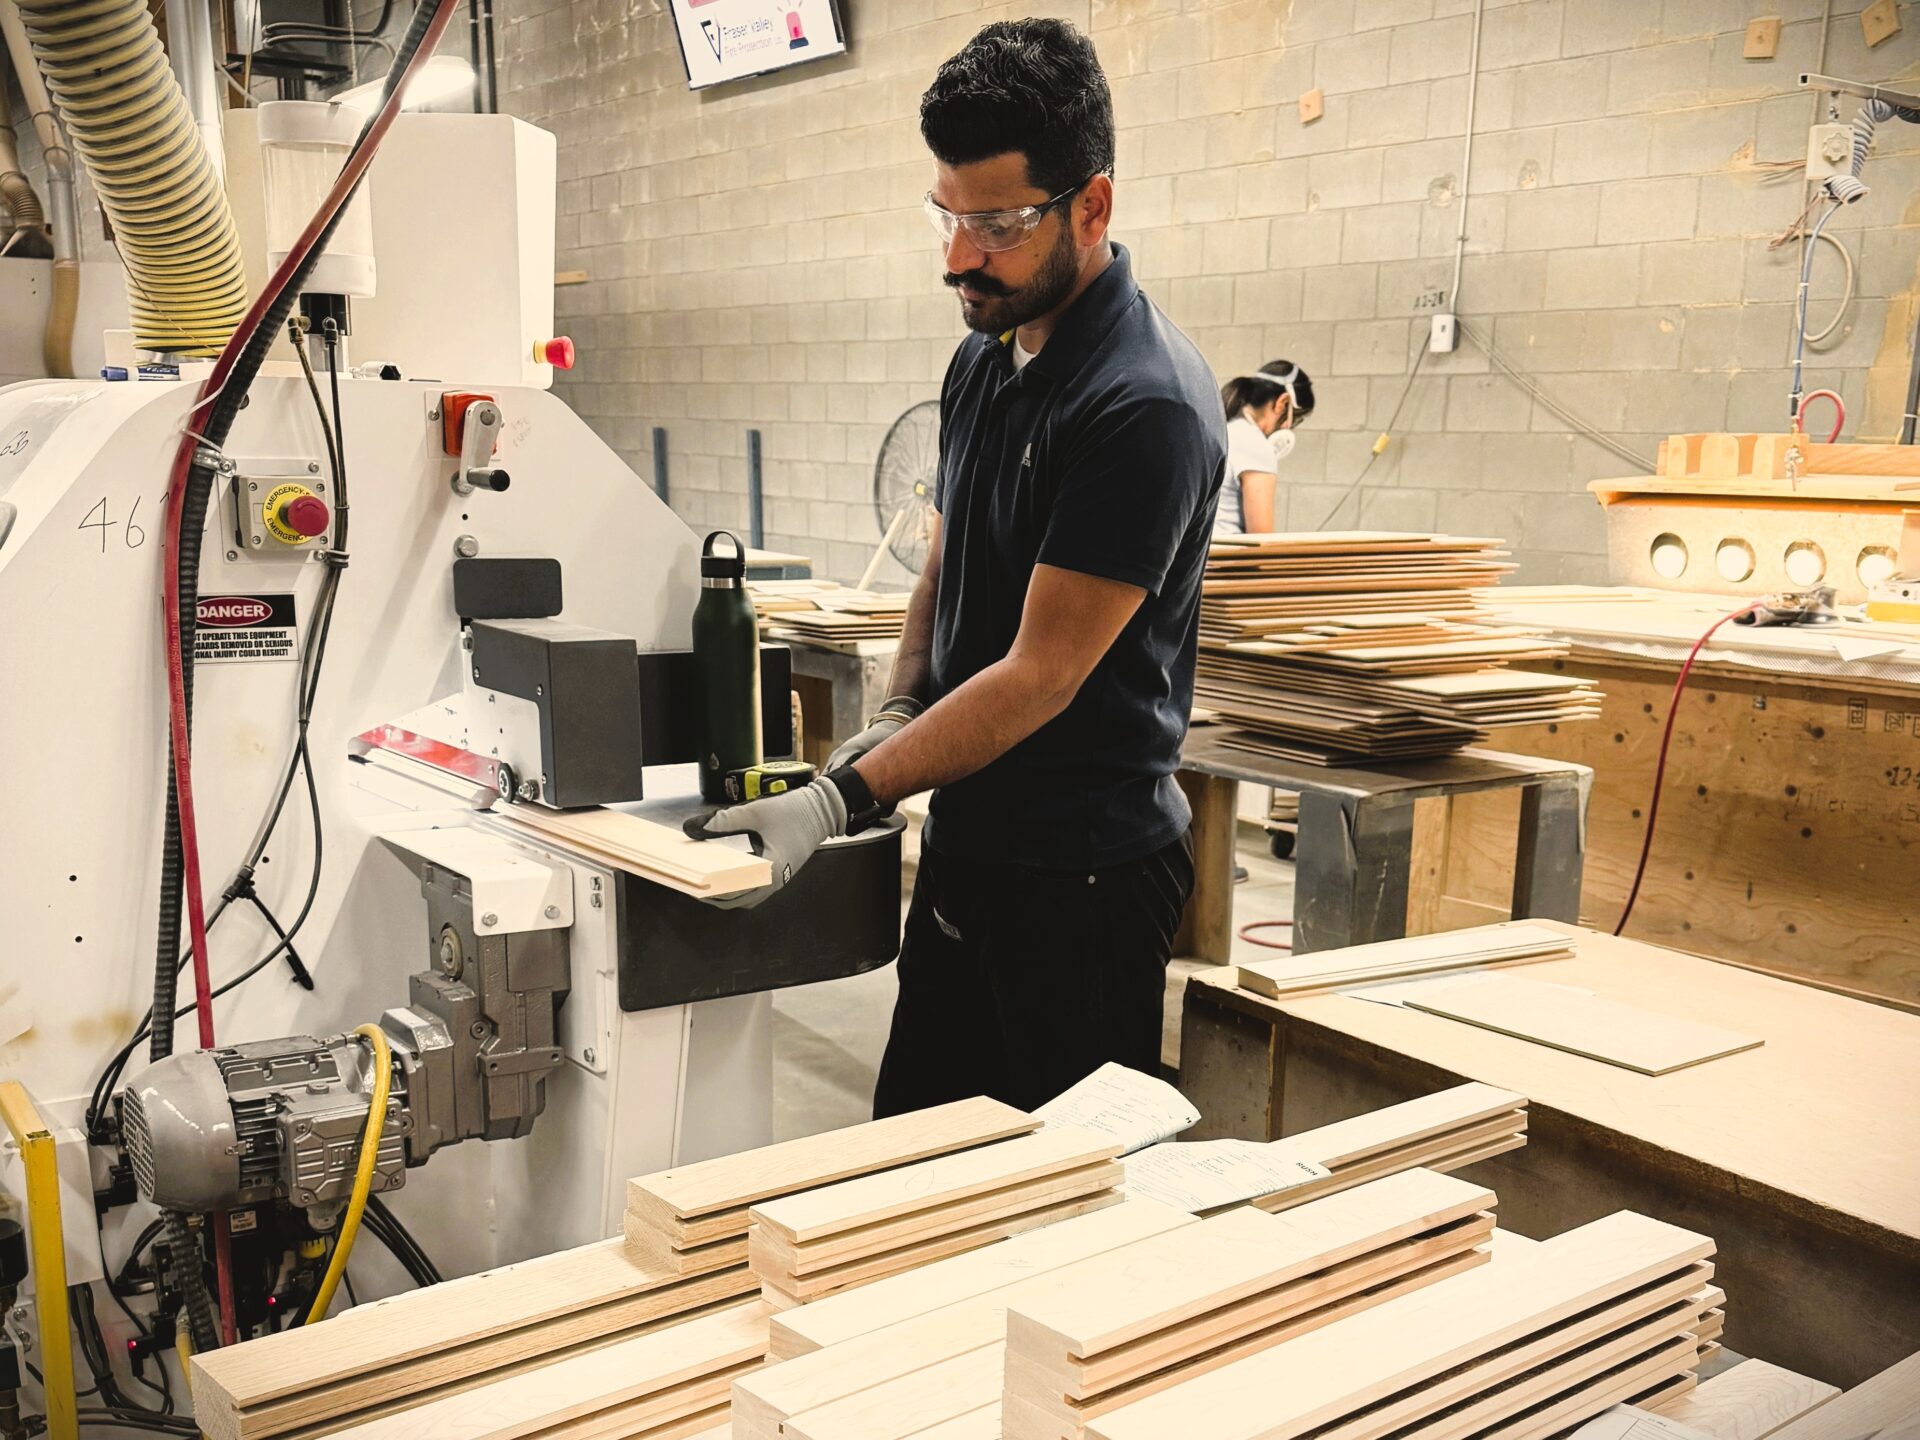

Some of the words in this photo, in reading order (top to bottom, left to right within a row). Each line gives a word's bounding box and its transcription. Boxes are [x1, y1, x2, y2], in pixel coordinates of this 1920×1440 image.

[196, 604, 265, 618] DANGER
[202, 632, 232, 641] OPERATE
[232, 631, 248, 640] THIS
[250, 630, 287, 640] EQUIPMENT
[221, 641, 253, 649] REMOVED
[254, 640, 264, 648] OR
[265, 639, 293, 648] SERIOUS
[214, 650, 237, 658] INJURY
[239, 649, 261, 658] COULD
[262, 648, 288, 657] RESULT!
